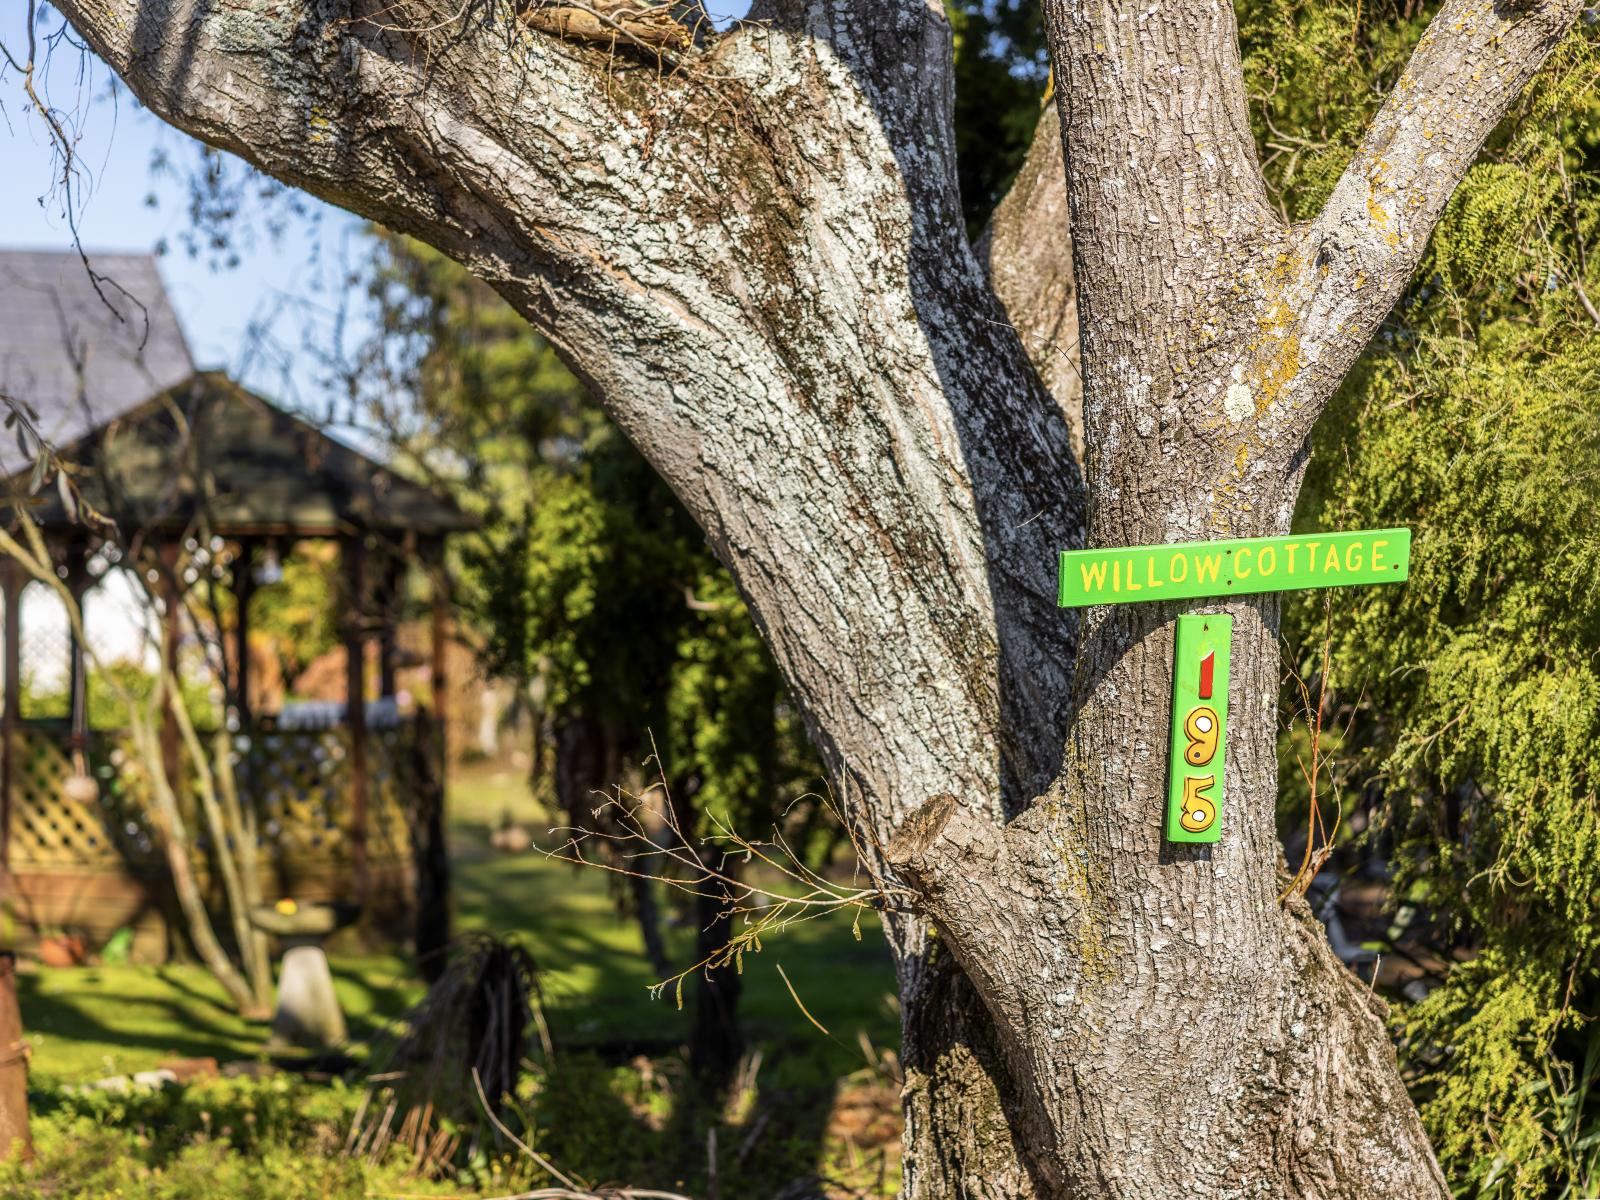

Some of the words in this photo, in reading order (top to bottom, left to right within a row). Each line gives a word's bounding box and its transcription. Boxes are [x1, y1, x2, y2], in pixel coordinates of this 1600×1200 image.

[1080, 553, 1222, 593] WILLOW
[1233, 540, 1389, 580] COTTAGE
[1179, 649, 1219, 832] 195
